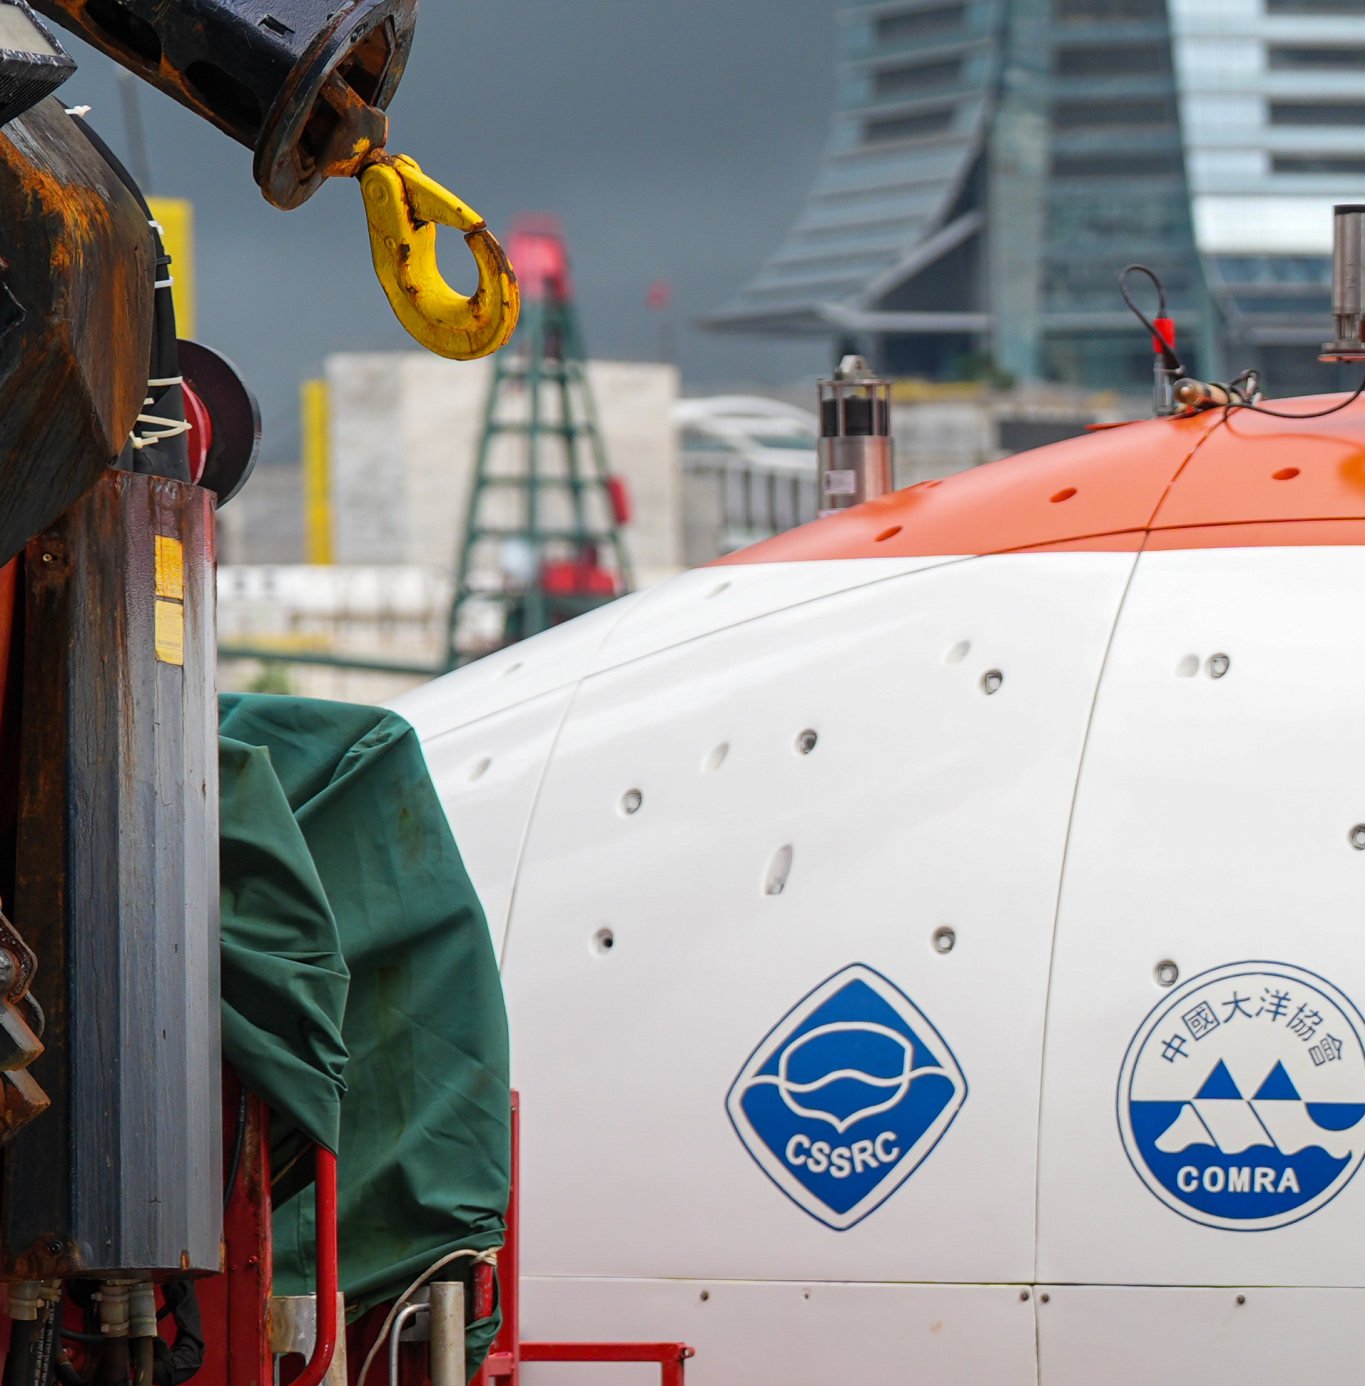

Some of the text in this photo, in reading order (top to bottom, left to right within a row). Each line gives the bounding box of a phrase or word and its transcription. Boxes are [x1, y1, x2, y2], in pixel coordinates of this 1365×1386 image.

[1160, 987, 1344, 1067] 中國大洋協會
[785, 1130, 900, 1180] CSSRC
[1176, 1165, 1301, 1193] COMRA
